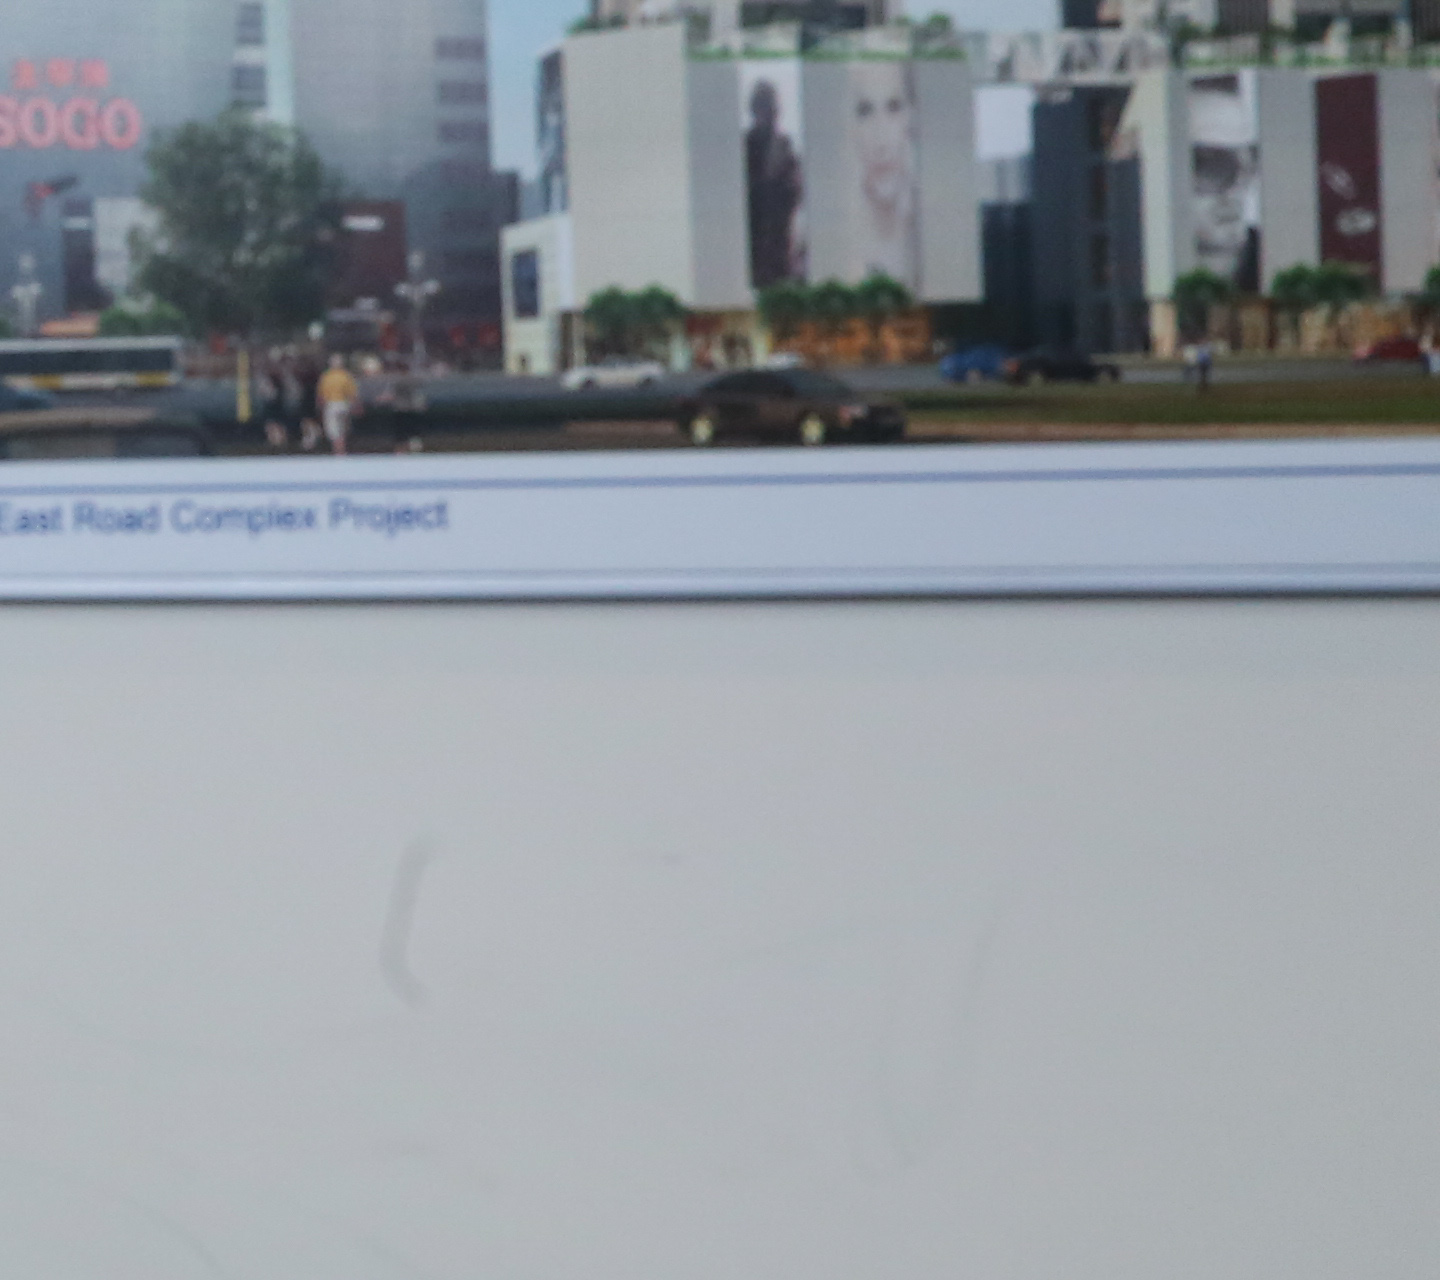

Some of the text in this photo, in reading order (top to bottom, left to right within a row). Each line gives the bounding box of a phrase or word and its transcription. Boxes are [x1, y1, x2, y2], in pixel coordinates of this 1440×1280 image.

[73, 499, 160, 534] Road
[169, 498, 317, 539] Complex
[329, 496, 448, 537] Project
